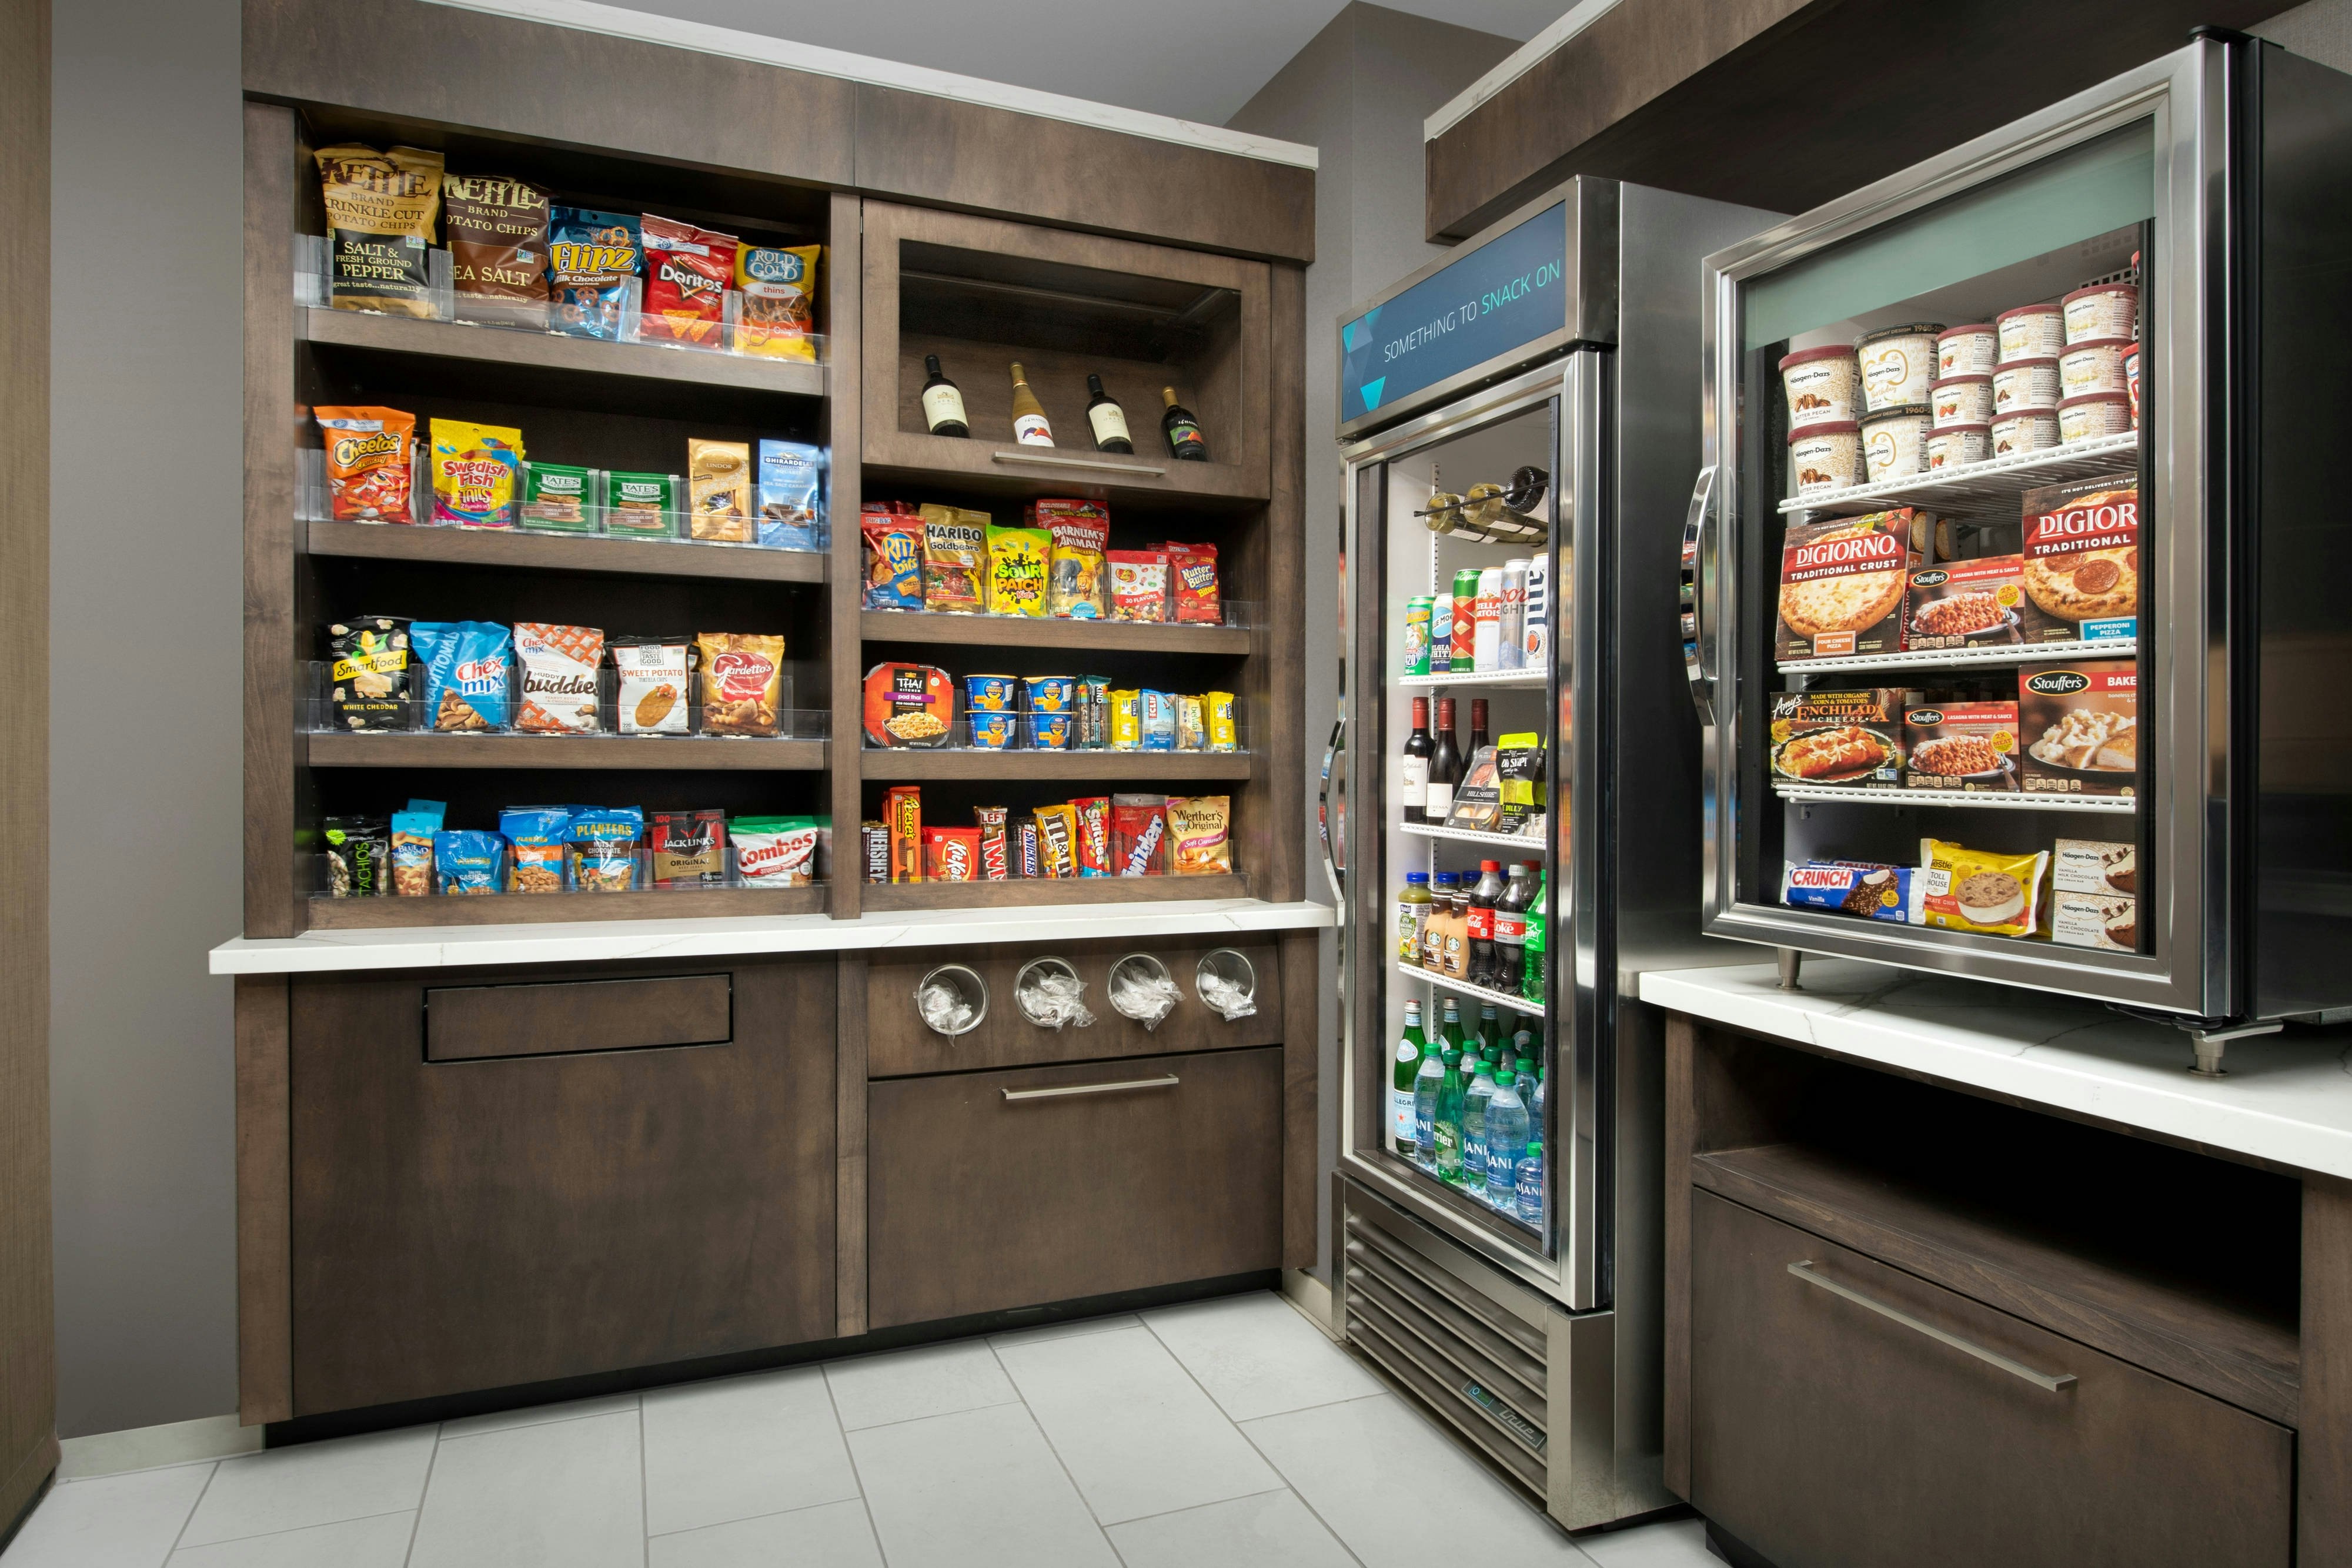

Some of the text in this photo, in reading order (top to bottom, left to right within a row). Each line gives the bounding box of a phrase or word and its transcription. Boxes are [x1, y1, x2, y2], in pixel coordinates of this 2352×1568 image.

[350, 192, 395, 206] BRAND
[327, 212, 376, 227] POTATO
[393, 210, 424, 220] CUT
[467, 206, 508, 218] BRAND
[447, 215, 538, 236] OTATO CHIPS
[344, 242, 399, 258] SALT &
[336, 255, 412, 268] FRESH GROUND
[551, 242, 636, 274] Flipz
[755, 250, 796, 266] ROLD
[342, 264, 405, 281] PEPPER
[447, 266, 530, 286] SEA SALT
[660, 265, 723, 293] Doritos
[750, 264, 797, 280] GOLD
[1384, 259, 1561, 363] SOMETHING TO SNACK ON
[1790, 371, 1830, 385] Häagen-Dazs
[334, 432, 402, 467] Cheetos
[355, 455, 387, 470] Crunchy
[442, 460, 510, 479] Swedish
[457, 472, 496, 489] Fish
[544, 476, 579, 485] TATE'S
[624, 484, 659, 493] TATE'S
[459, 489, 491, 504] TAILS
[926, 524, 982, 541] HARIBO
[1052, 525, 1105, 541] BARNUM'S
[883, 534, 918, 561] RITZ
[931, 540, 980, 552] Goldbears
[1058, 535, 1102, 551] ANIMALS
[2034, 534, 2131, 554] TRADITIONAL
[893, 558, 918, 574] bits
[998, 564, 1040, 579] SOUR
[1182, 564, 1211, 580] Nutter
[1791, 560, 1897, 580] TRADITIONAL CRUST
[996, 577, 1043, 592] PATCH
[1187, 571, 1214, 589] Butter
[1916, 573, 1945, 584] Stouffer's
[1016, 591, 1034, 599] Kids
[1134, 594, 1157, 603] FLAVORS
[1197, 586, 1216, 597] Bites
[1999, 592, 2018, 600] MEAT
[522, 638, 546, 647] Chex
[526, 646, 544, 654] mix
[337, 655, 403, 677] Smartfood
[456, 656, 505, 681] Chex
[712, 654, 771, 689] Gardetto's
[462, 674, 505, 696] mix
[897, 678, 923, 688] THAI
[2033, 676, 2082, 691] Stouffer's
[1772, 695, 1803, 720] Amy's
[1796, 705, 1889, 723] ENCHILADA
[1912, 713, 1940, 723] Stouffer's
[903, 794, 920, 840] Reese's
[981, 813, 1006, 823] LEFT
[1173, 810, 1223, 821] Werther's
[577, 824, 632, 837] PLANTERS
[1187, 820, 1222, 831] Original
[663, 840, 686, 848] JACK
[1085, 809, 1104, 864] Skittles
[1198, 835, 1223, 844] Caramels
[399, 844, 417, 852] BLUE
[1025, 832, 1036, 876] SNICKERS
[2062, 852, 2099, 861] Häagen-Dazs
[1792, 870, 1852, 886] CRUNCH
[1927, 880, 1948, 888] HOUSE
[2062, 904, 2099, 914] Häagen-Dazs
